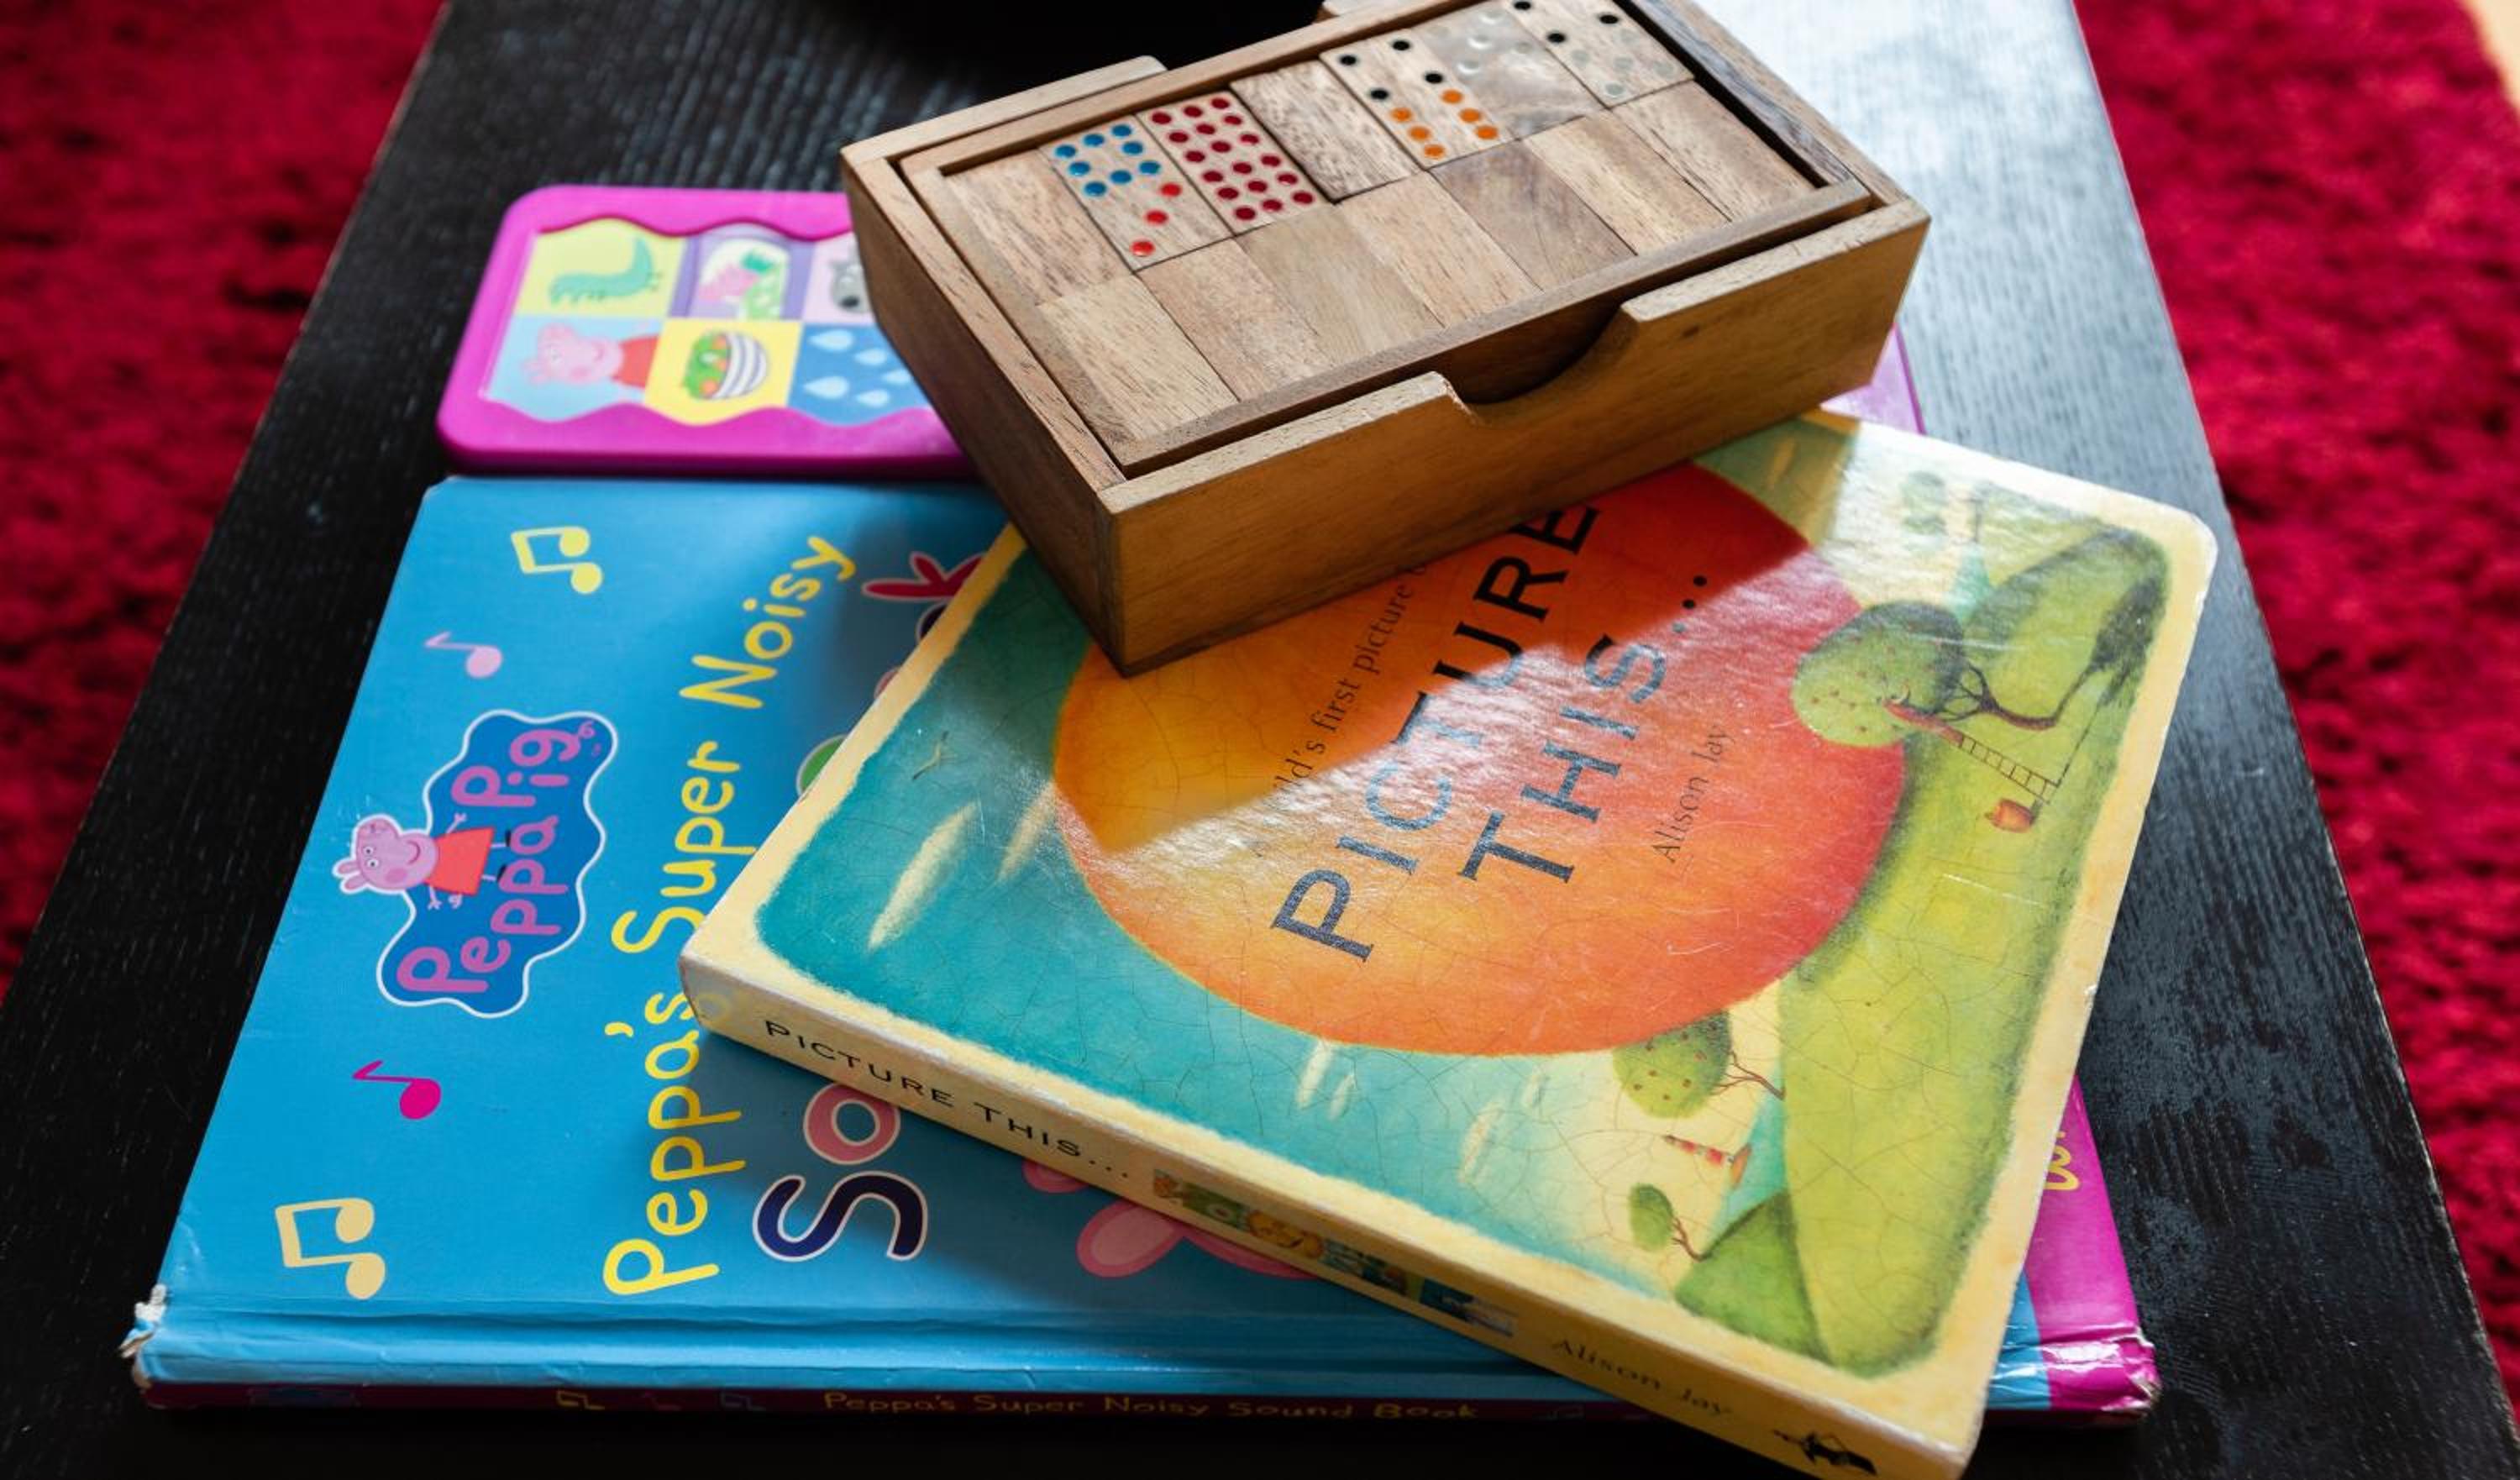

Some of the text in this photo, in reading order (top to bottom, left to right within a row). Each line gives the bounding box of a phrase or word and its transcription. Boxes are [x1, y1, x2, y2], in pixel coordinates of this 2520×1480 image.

[1271, 506, 1602, 963] PICTURE
[1310, 678, 1361, 732] first
[1352, 585, 1413, 675] picture
[1457, 575, 1707, 884] THIS...
[396, 721, 595, 993] Peppa Pig
[1651, 776, 1709, 863] Alison
[603, 536, 857, 1295] Peppa's Super Noisy
[764, 1021, 1129, 1178] PICTURE THIS...
[823, 1391, 1478, 1420] Peppa's Super Noisy Sound Book
[1551, 1339, 1734, 1417] Alison Jay
